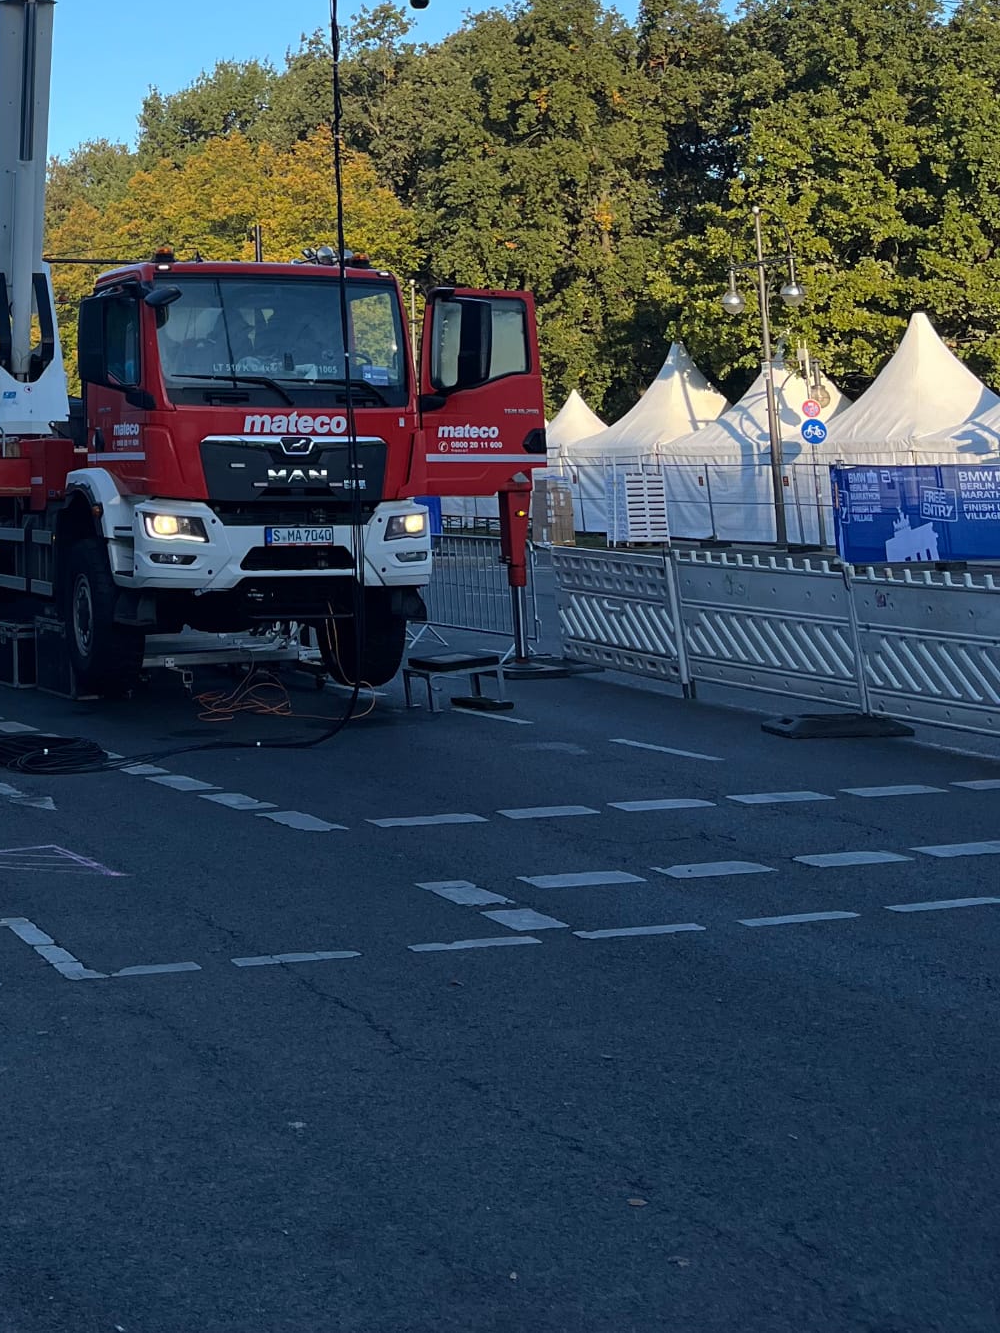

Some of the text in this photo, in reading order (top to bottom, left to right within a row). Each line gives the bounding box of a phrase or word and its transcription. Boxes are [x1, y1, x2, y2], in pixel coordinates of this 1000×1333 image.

[113, 421, 140, 436] mateco
[243, 410, 348, 434] mateco
[438, 423, 499, 438] mateco
[480, 441, 488, 449] 11
[267, 469, 328, 483] MAN
[848, 473, 866, 483] BMW
[958, 471, 993, 482] BMW
[960, 482, 996, 491] BERLIN
[923, 489, 946, 505] FREE
[923, 503, 953, 516] ENTRY
[963, 503, 995, 512] FINISH
[273, 529, 332, 543] S MA 7040
